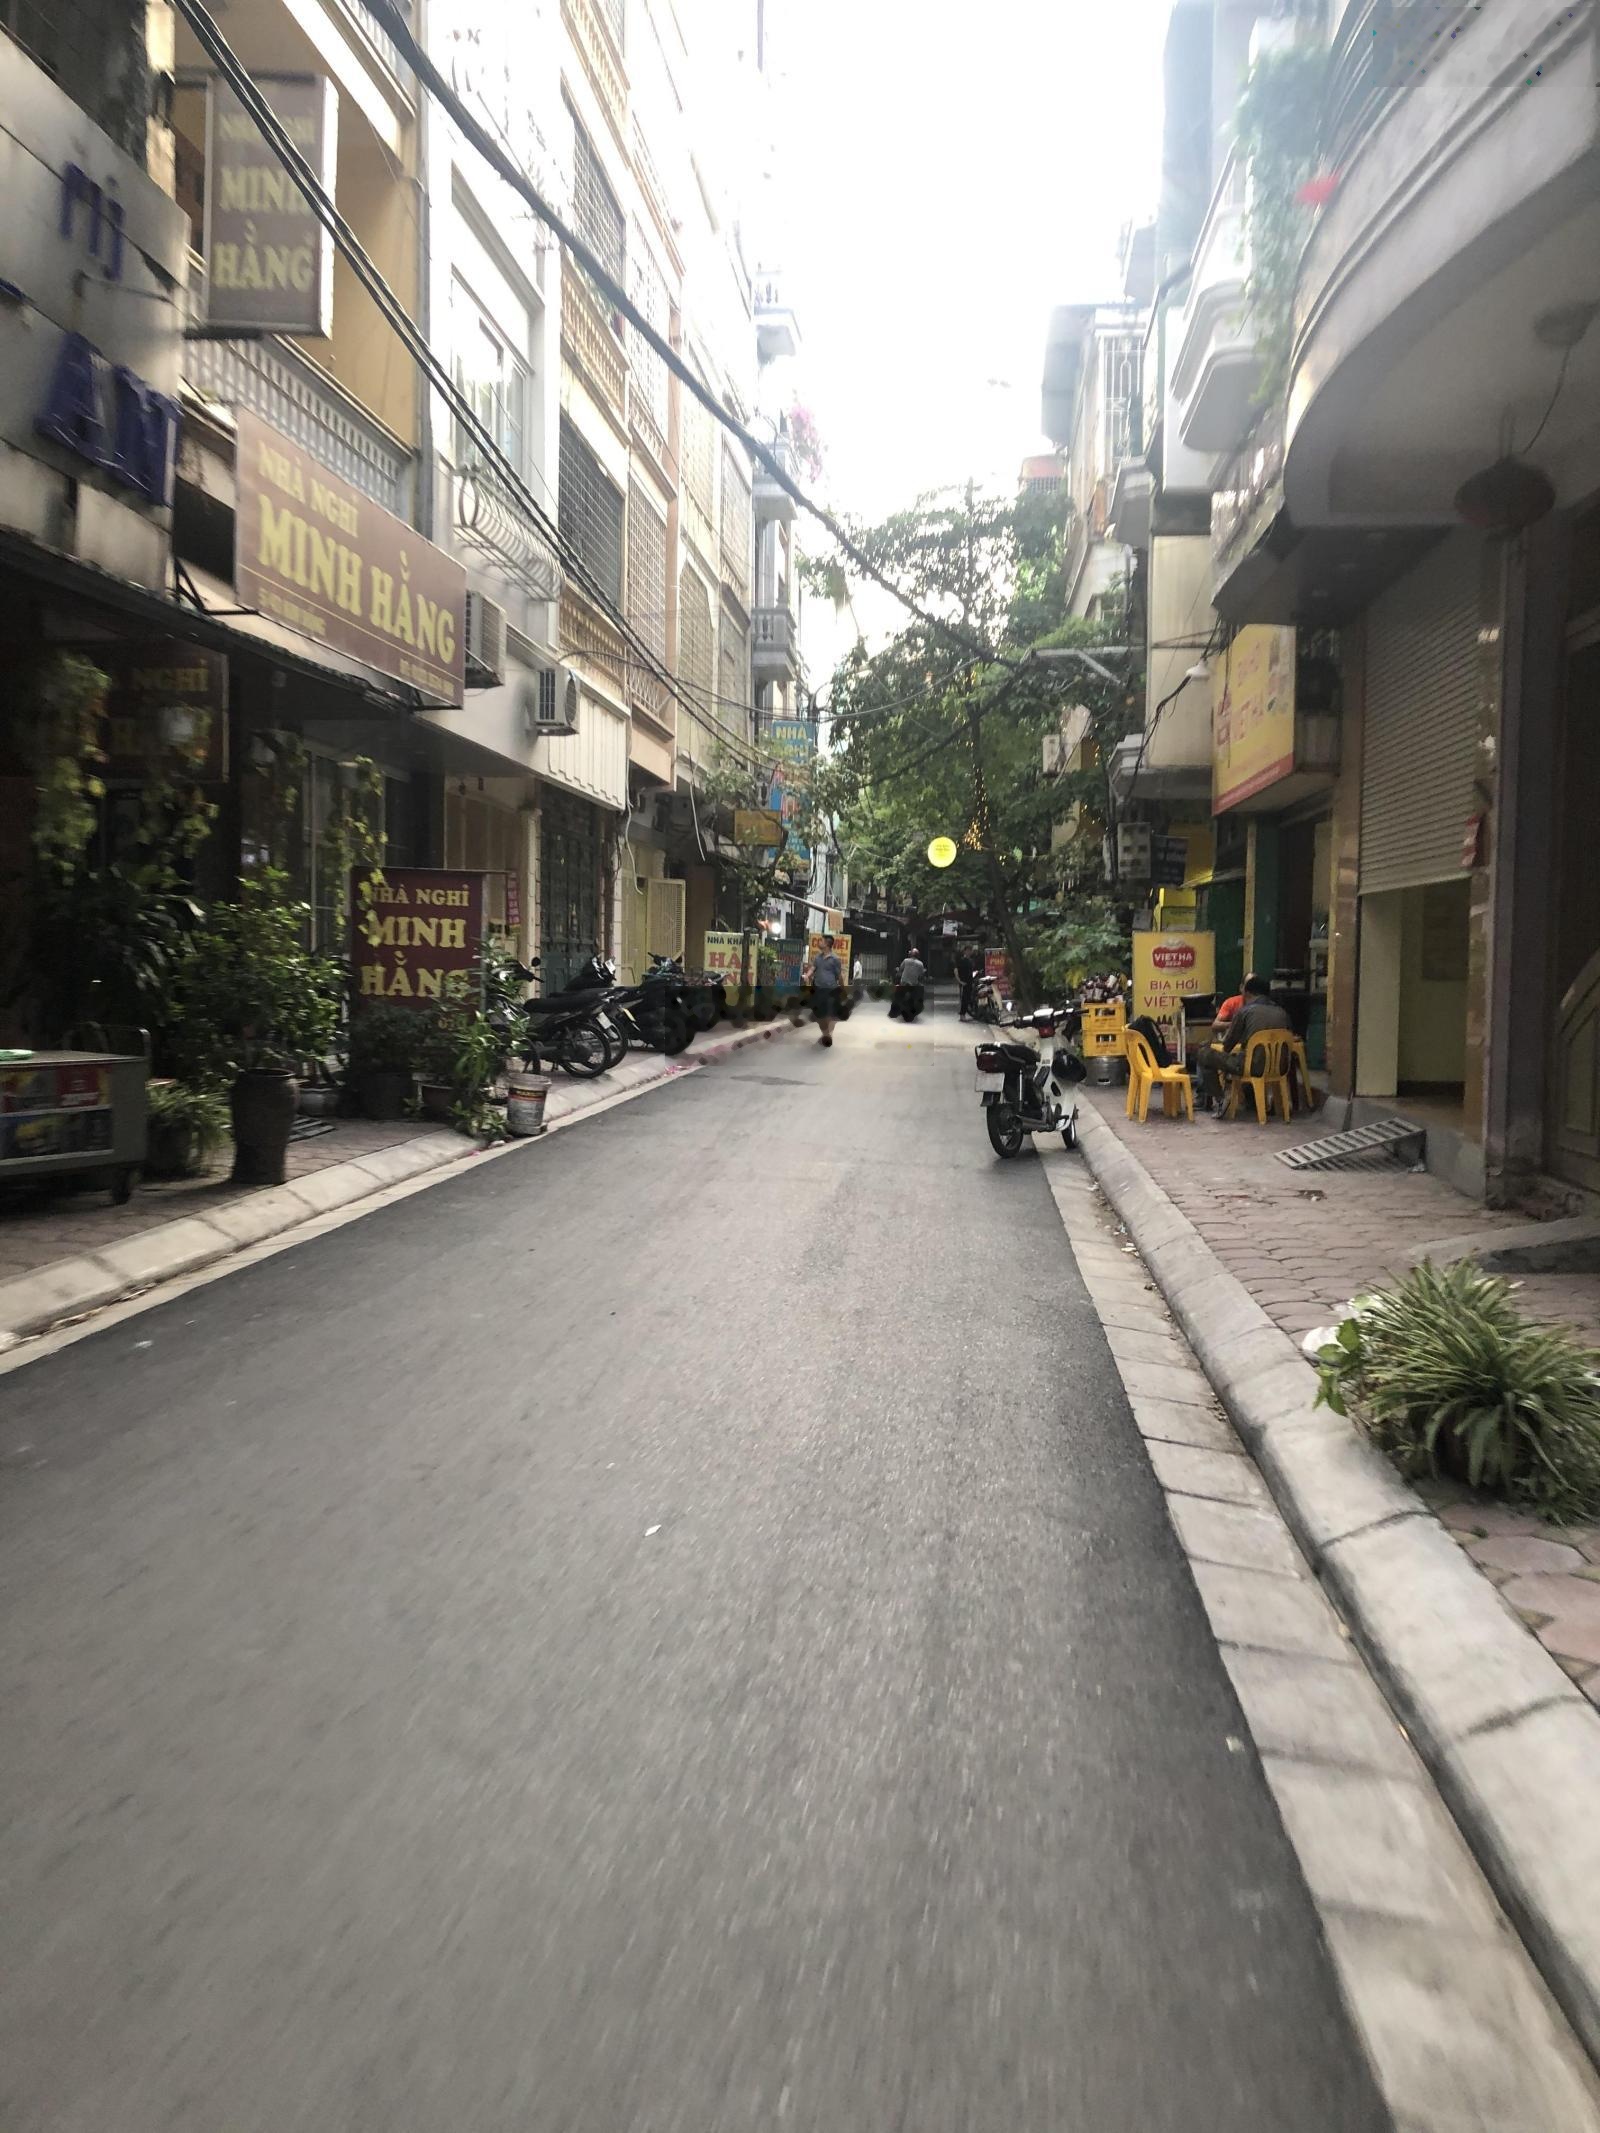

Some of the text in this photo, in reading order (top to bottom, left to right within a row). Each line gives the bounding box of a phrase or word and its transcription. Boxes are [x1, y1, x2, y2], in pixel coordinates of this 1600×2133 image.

[258, 441, 358, 538] NHÀ NGHỈ
[256, 493, 363, 617] MINH
[369, 550, 456, 665] HẰNG
[415, 884, 469, 907] NGHỈ
[369, 915, 466, 948] MINH
[1150, 980, 1171, 991] BIA
[1144, 992, 1177, 1010] VIỆT
